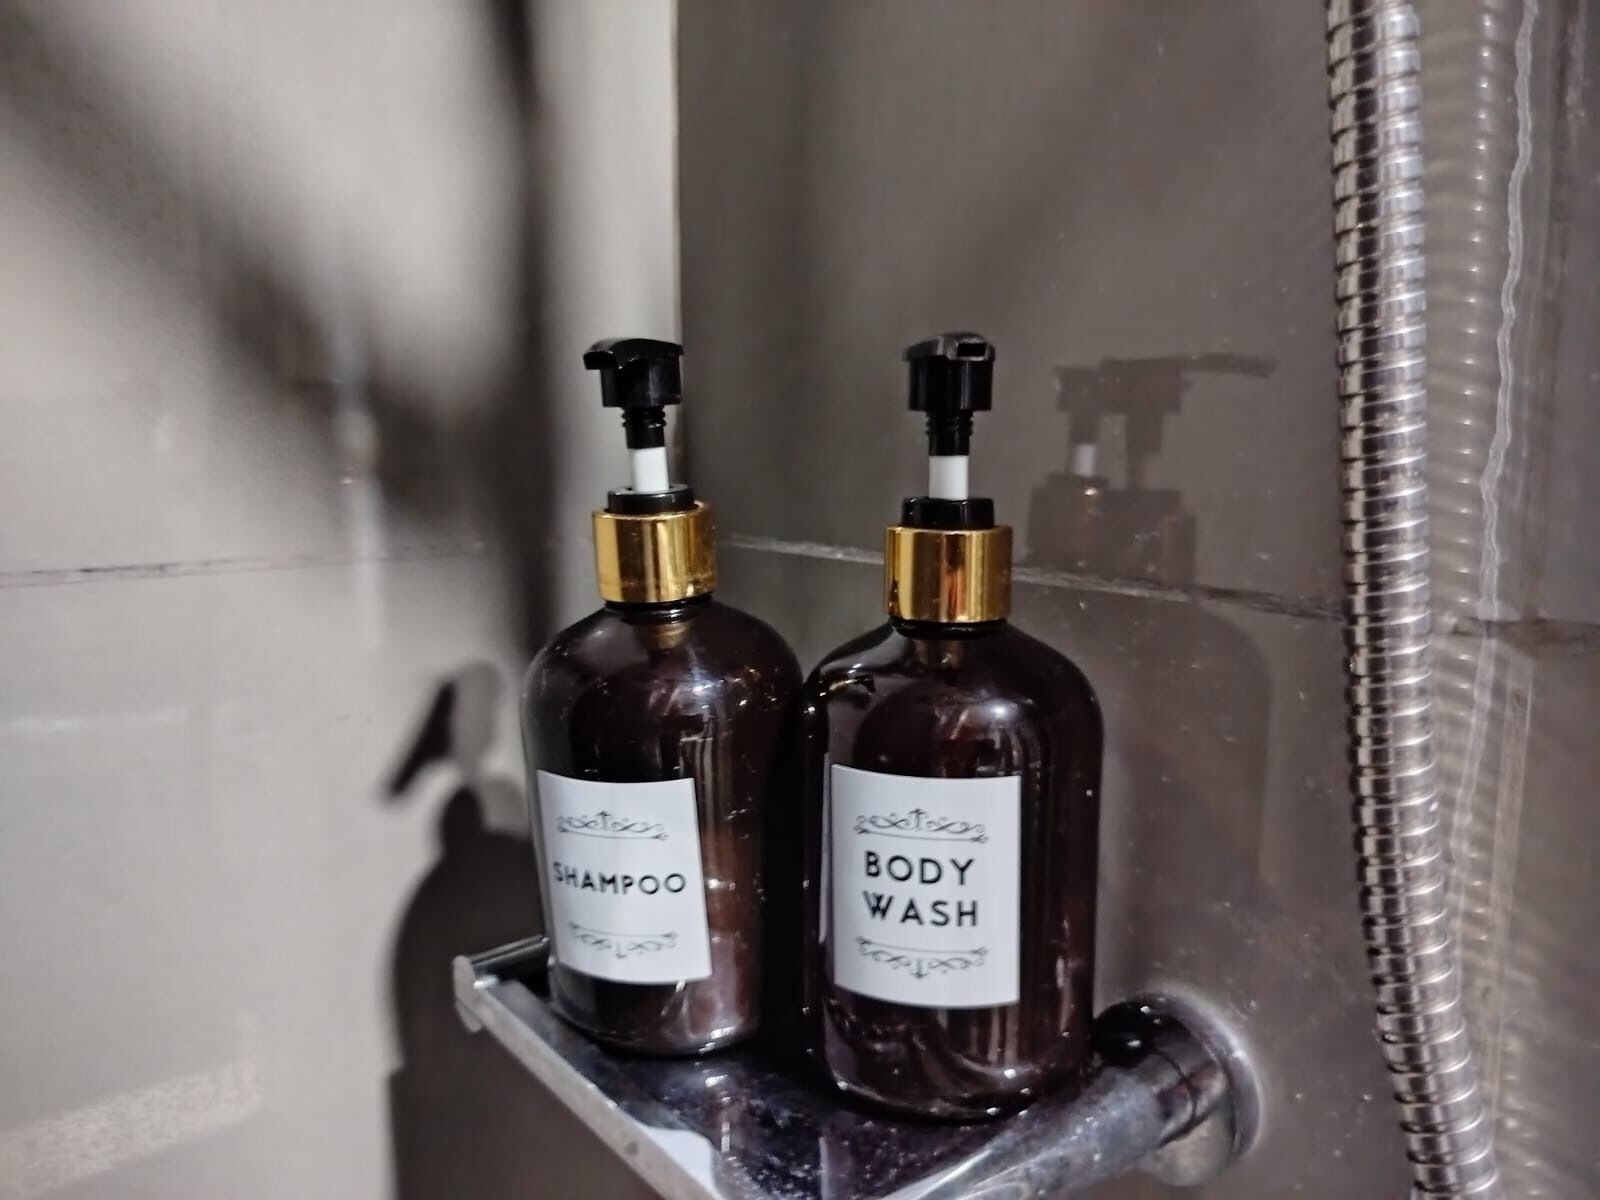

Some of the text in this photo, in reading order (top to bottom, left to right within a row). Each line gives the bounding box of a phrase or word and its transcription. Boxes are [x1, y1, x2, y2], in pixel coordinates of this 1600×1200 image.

[552, 861, 687, 895] SHAMPOO
[864, 850, 974, 886] BODY
[862, 890, 978, 927] WASH
